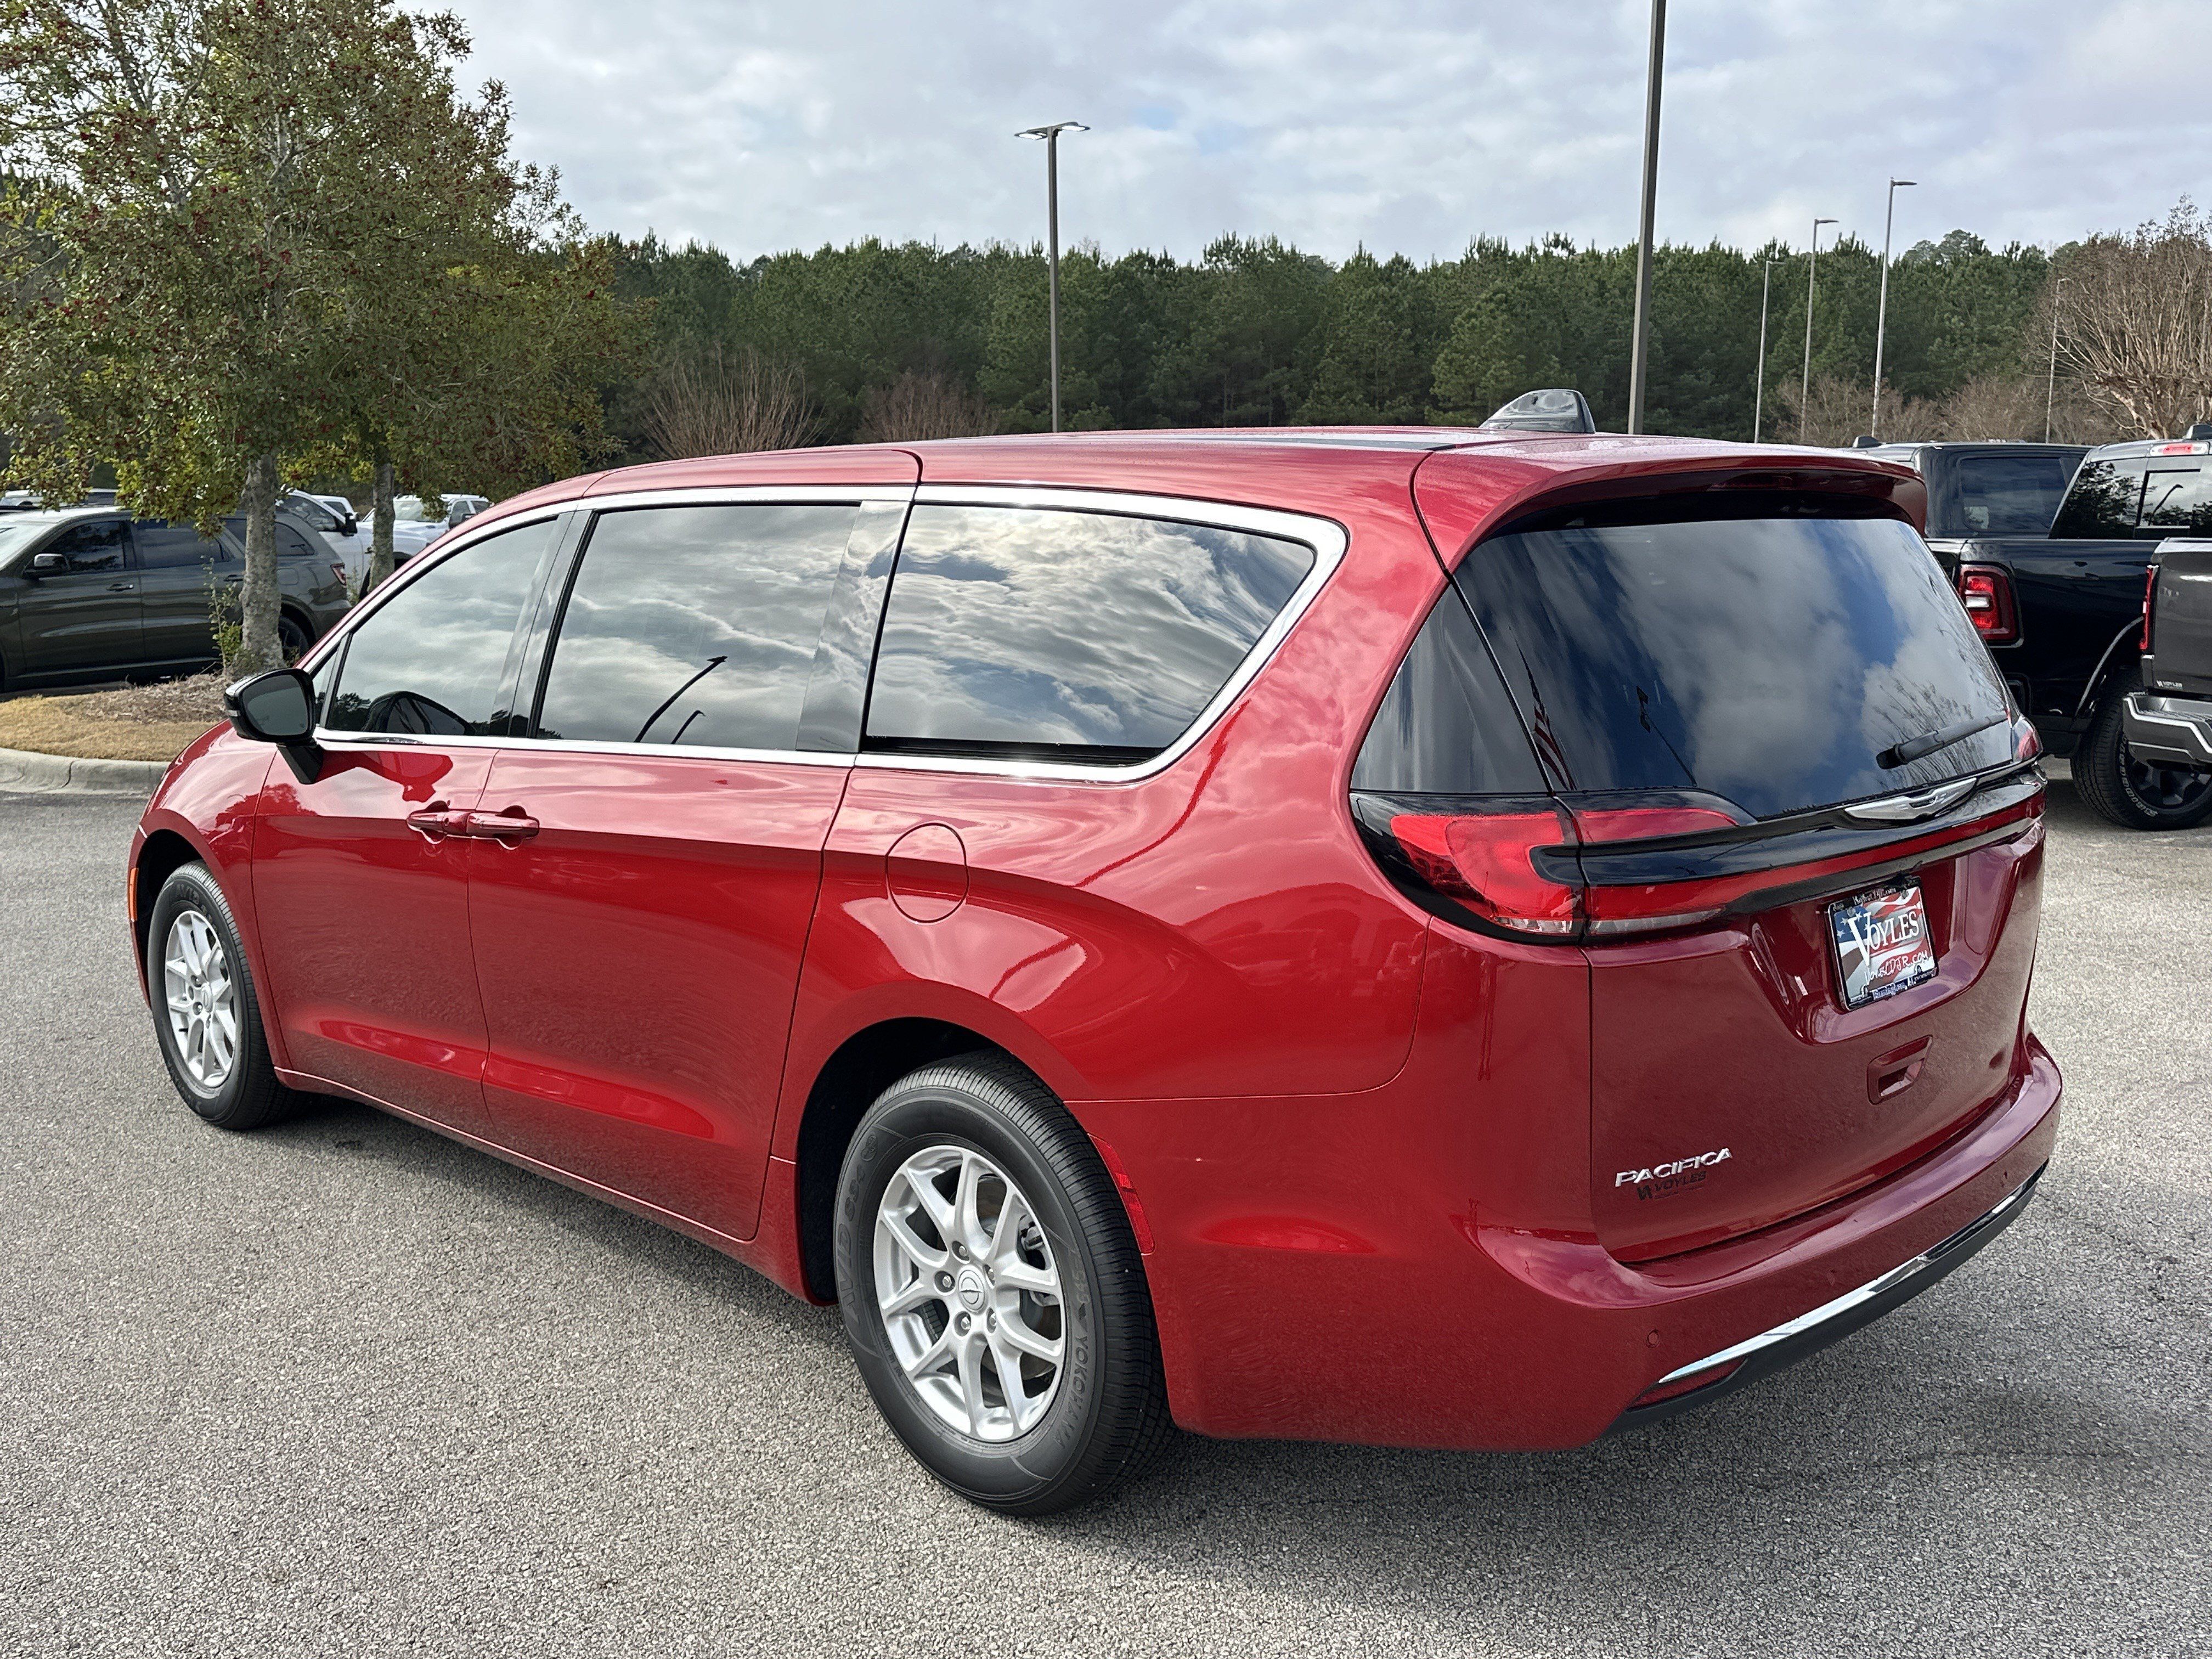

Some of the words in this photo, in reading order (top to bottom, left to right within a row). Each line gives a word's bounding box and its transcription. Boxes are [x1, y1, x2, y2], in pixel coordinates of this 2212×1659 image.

[1847, 911, 1920, 967] VOYLES
[1615, 1148, 1733, 1187] PACIFICA
[1655, 1171, 1707, 1192] VOYLES
[837, 1223, 860, 1326] AVID
[1053, 1335, 1089, 1449] YOKOHAMA
